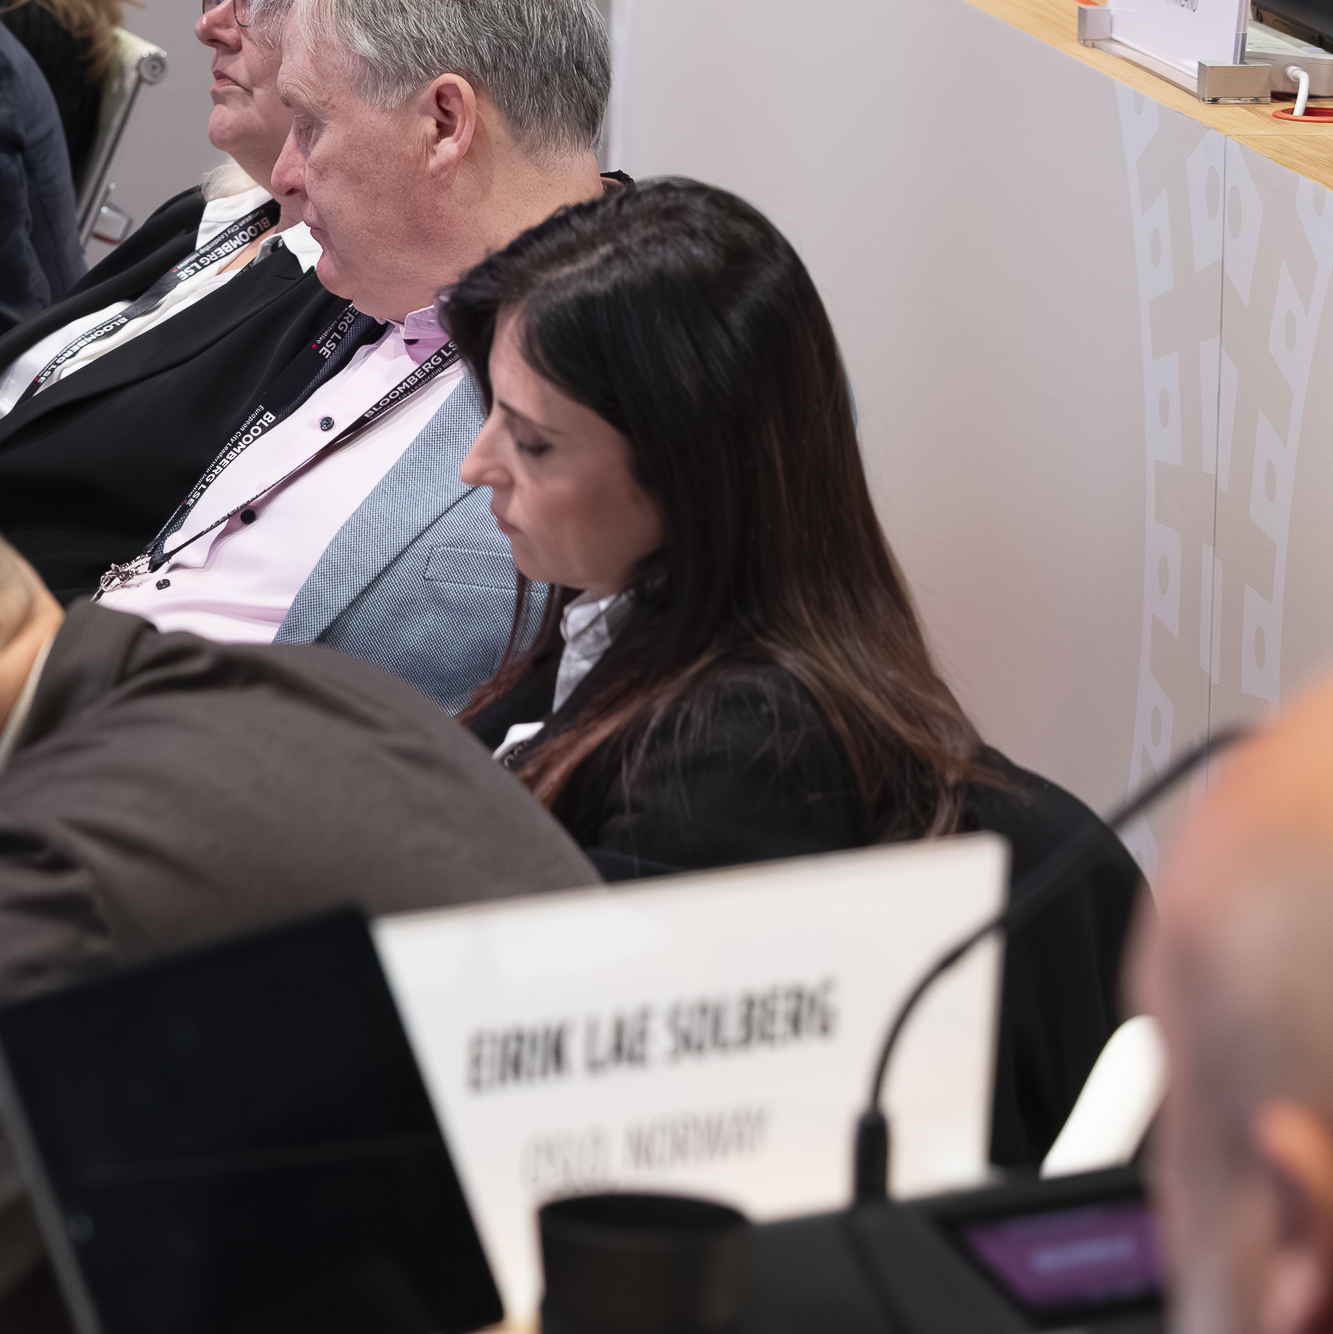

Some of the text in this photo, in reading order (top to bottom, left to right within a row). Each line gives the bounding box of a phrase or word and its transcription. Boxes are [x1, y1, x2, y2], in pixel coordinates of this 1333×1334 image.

[199, 217, 270, 266] BLOOMBERG
[177, 262, 202, 280] LSE
[37, 317, 128, 383] BLOOMBERG LSE
[318, 332, 342, 358] LSE
[364, 340, 459, 418] BLOOMBERG LS
[411, 367, 442, 392] Leadership
[240, 405, 264, 431] European
[205, 411, 276, 483] BLOOMBERG
[230, 431, 241, 444] City
[186, 483, 207, 506] LSE
[466, 976, 839, 1094] EIRIK LAE SOLBERG
[624, 1104, 771, 1174] NORWAY
